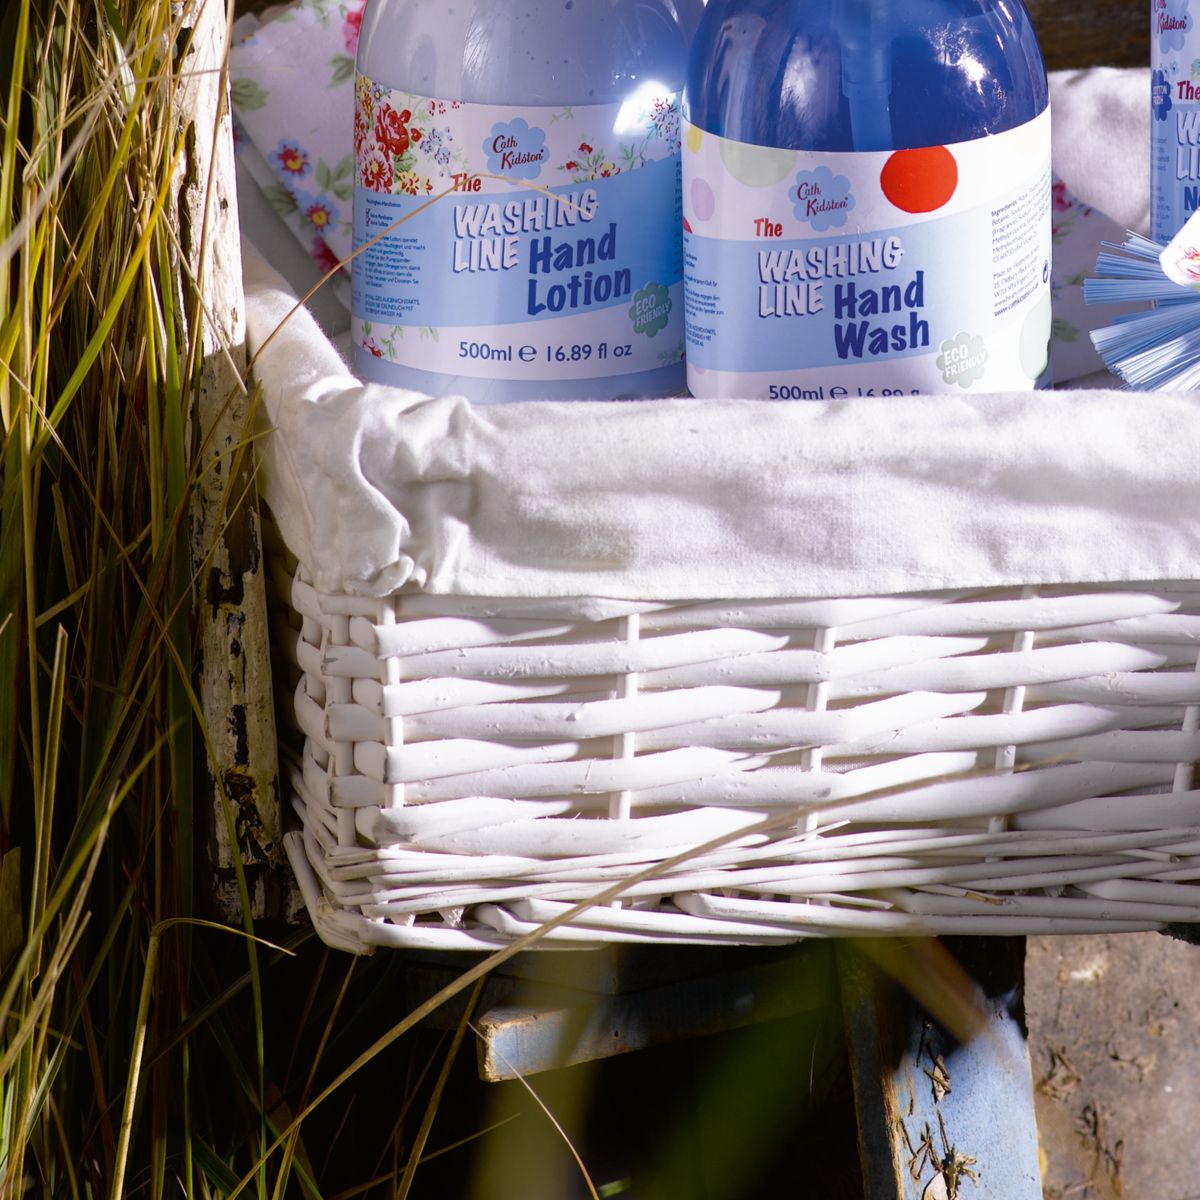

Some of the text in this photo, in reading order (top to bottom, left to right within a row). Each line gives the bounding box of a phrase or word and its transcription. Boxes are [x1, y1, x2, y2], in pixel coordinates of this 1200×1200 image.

[493, 135, 517, 153] Cath
[450, 173, 481, 192] The
[797, 182, 822, 200] Cath
[454, 188, 598, 239] WASHING
[754, 217, 783, 237] The
[453, 236, 519, 273] LINE
[529, 222, 617, 275] Hand
[758, 236, 903, 284] WASHING
[527, 268, 631, 315] Lotion
[758, 281, 824, 319] LINE
[834, 271, 925, 320] Hand
[635, 294, 656, 315] ECO
[635, 302, 672, 327] FRIENDLY
[834, 311, 930, 360] Wash
[458, 341, 511, 362] 500ml
[547, 343, 592, 362] 16.89
[598, 343, 608, 359] fl
[613, 344, 633, 357] oz
[943, 343, 969, 366] ECO
[944, 351, 987, 378] FRIENDLY
[769, 385, 824, 400] 500ml
